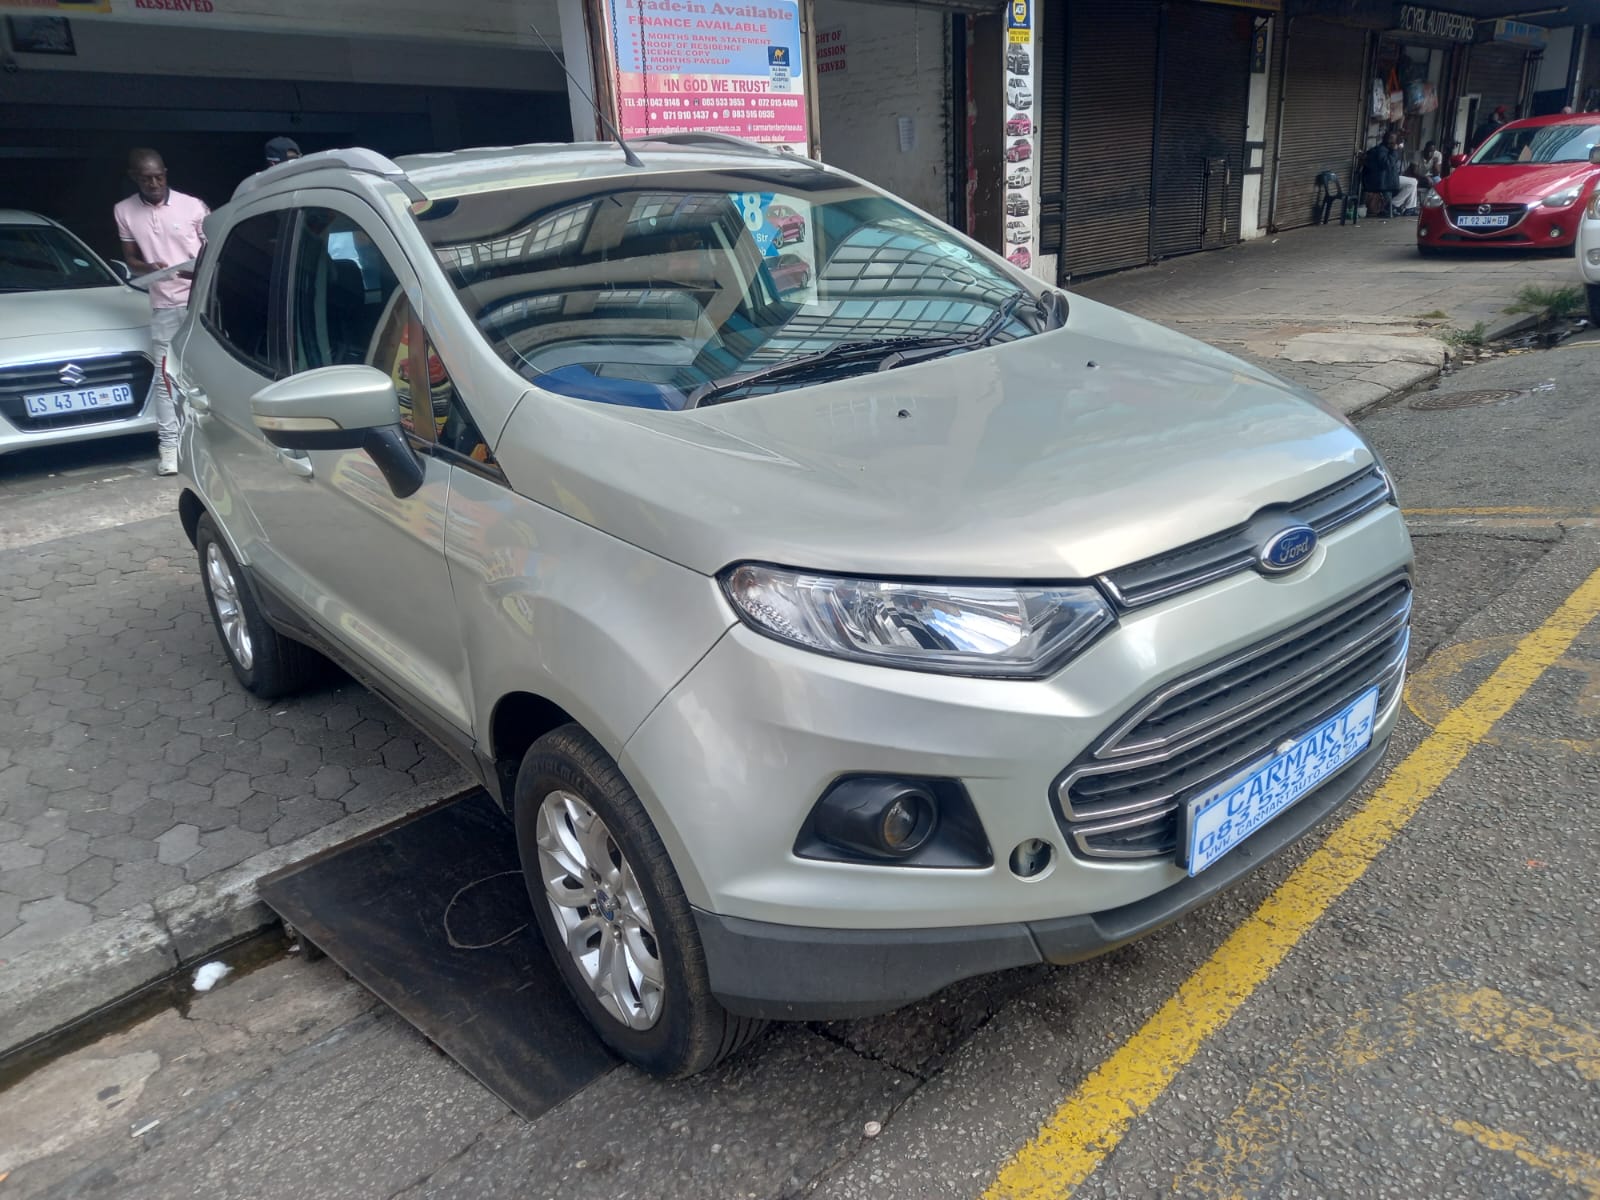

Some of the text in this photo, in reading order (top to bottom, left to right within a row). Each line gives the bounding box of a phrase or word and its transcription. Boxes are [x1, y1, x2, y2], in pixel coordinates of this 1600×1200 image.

[135, 0, 214, 13] RESERVED
[711, 3, 793, 20] Available
[628, 15, 768, 32] FINANCE AVAILABLE
[648, 33, 772, 45] MONTHS BANK STATEMENT
[816, 30, 841, 44] GHT OF
[642, 41, 673, 49] ROOF
[690, 43, 743, 51] RESIDENCE
[644, 48, 710, 57] ICENCE COPY
[816, 44, 846, 59] MISSION
[650, 56, 731, 65] MONTHS PAYSLIP
[817, 59, 846, 73] SERVED
[656, 64, 682, 72] COPY
[684, 80, 708, 92] GOD
[710, 80, 728, 92] WE
[1497, 216, 1507, 225] GP
[28, 387, 129, 413] LS 43 TG GP
[1279, 533, 1309, 562] Ford
[1226, 710, 1353, 817] CARMART
[1199, 715, 1369, 855] 083 533 3653
